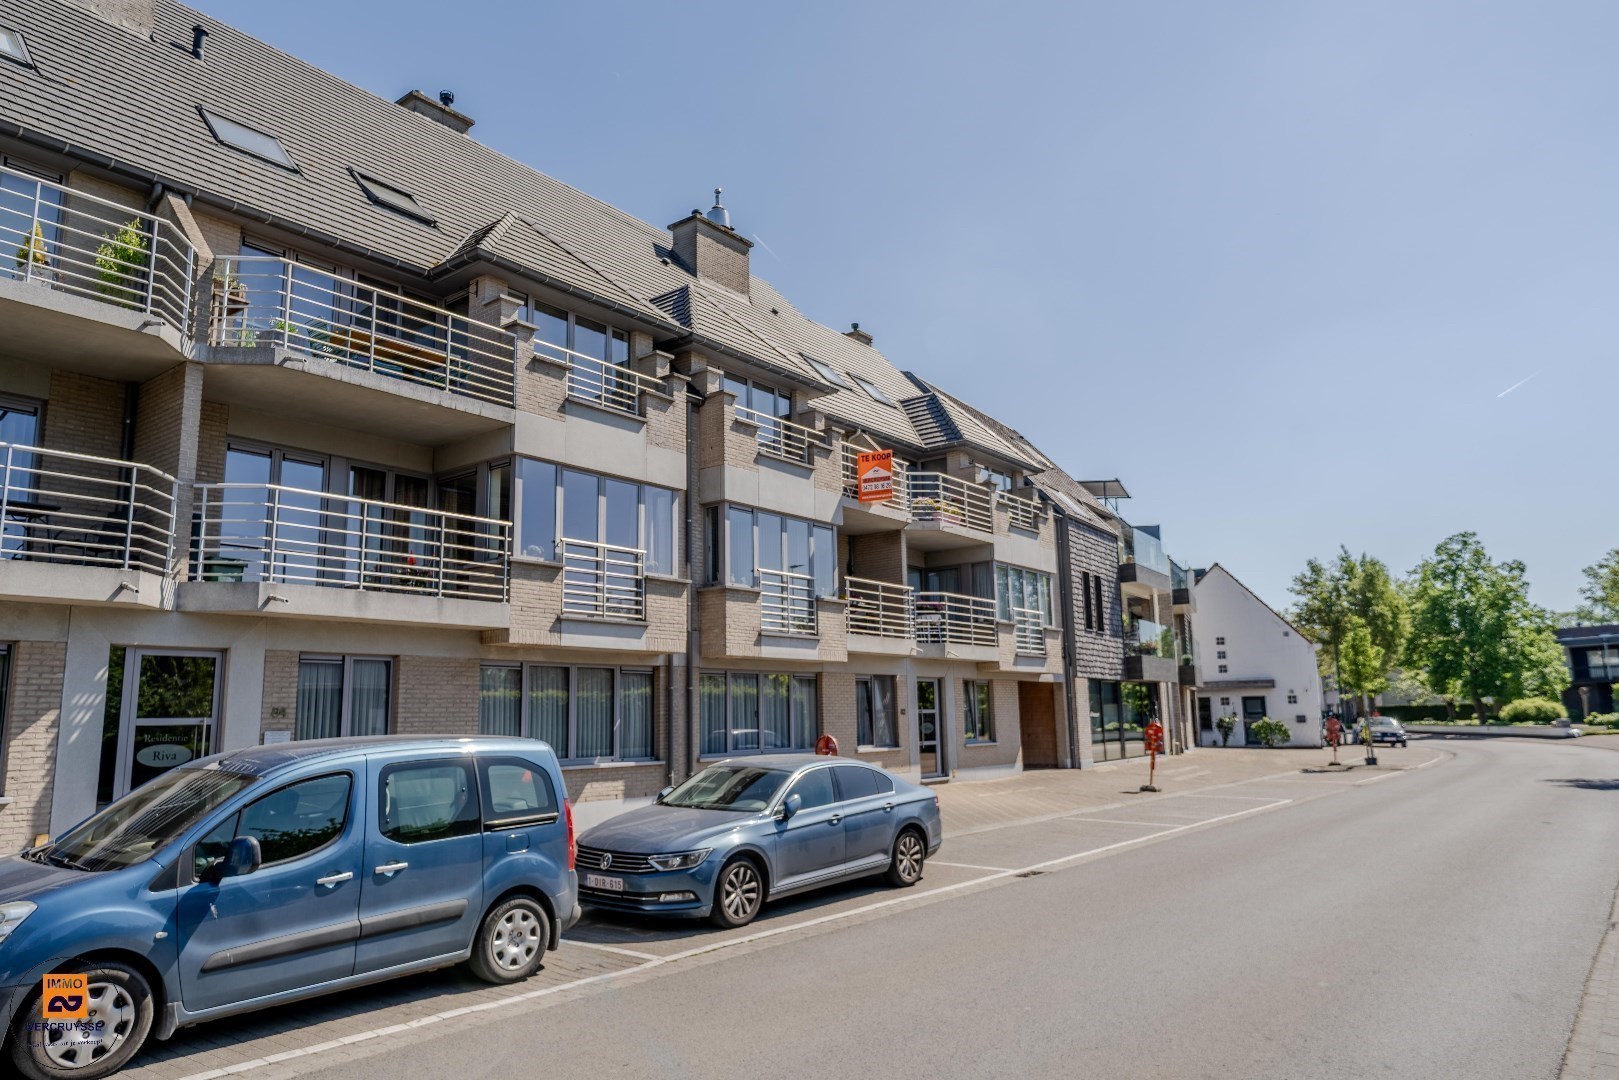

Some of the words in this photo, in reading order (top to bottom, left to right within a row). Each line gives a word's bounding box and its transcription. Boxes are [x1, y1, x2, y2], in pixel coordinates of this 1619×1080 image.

[872, 453, 891, 461] KOOP
[144, 734, 188, 742] Residentie
[153, 751, 177, 760] Riva
